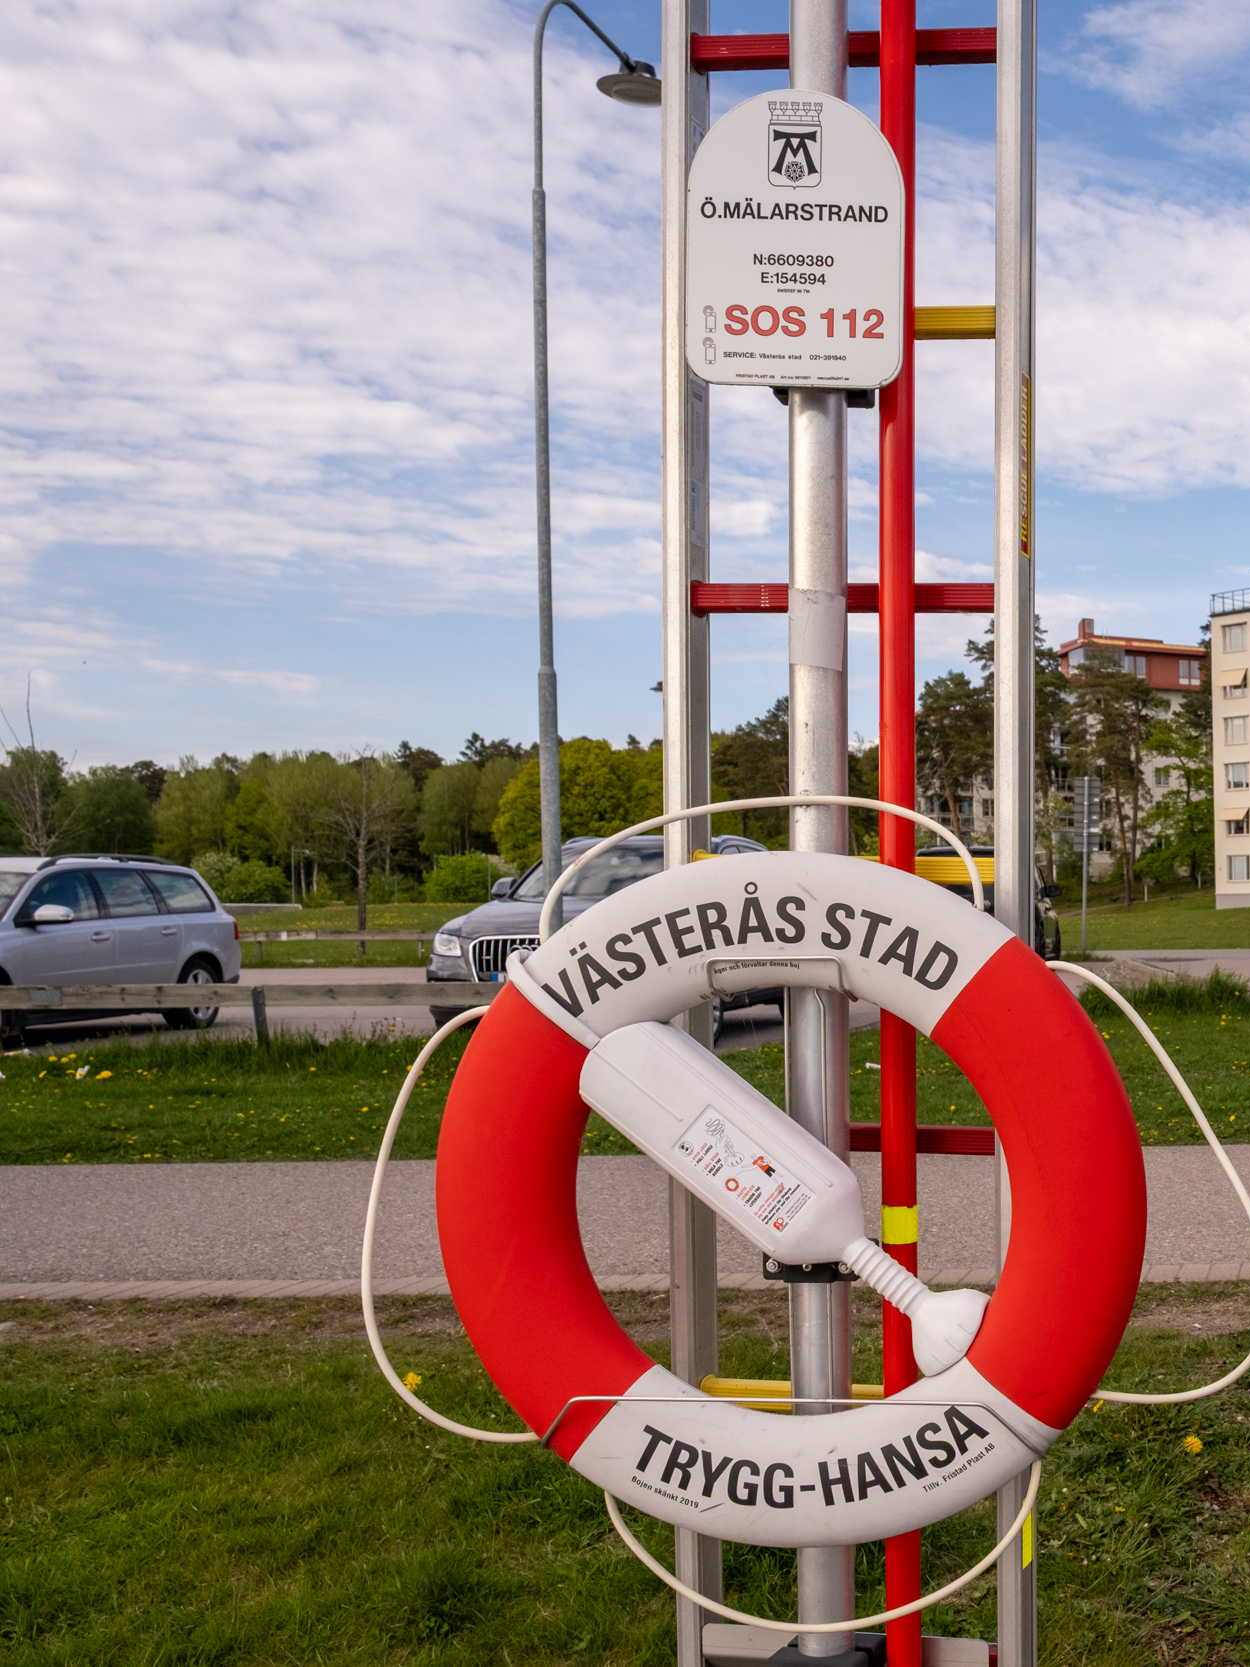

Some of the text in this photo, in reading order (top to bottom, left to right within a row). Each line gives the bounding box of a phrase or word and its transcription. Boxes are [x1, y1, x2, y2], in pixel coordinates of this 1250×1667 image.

[700, 196, 889, 224] Ö.MÄLARSTRAND
[753, 253, 834, 267] N:6609380
[761, 272, 826, 285] E:154594
[723, 304, 885, 339] SOS 112
[723, 351, 757, 359] SERVICE:
[759, 352, 786, 360] Västerås
[1021, 386, 1029, 462] LADDER
[541, 882, 959, 1018] VÄSTERÅS STAD
[634, 1405, 990, 1509] TRYGG-HANSA
[922, 1443, 995, 1493] Tillv. Fristad Plast AB
[631, 1475, 699, 1509] Bojen skänkt 2019
